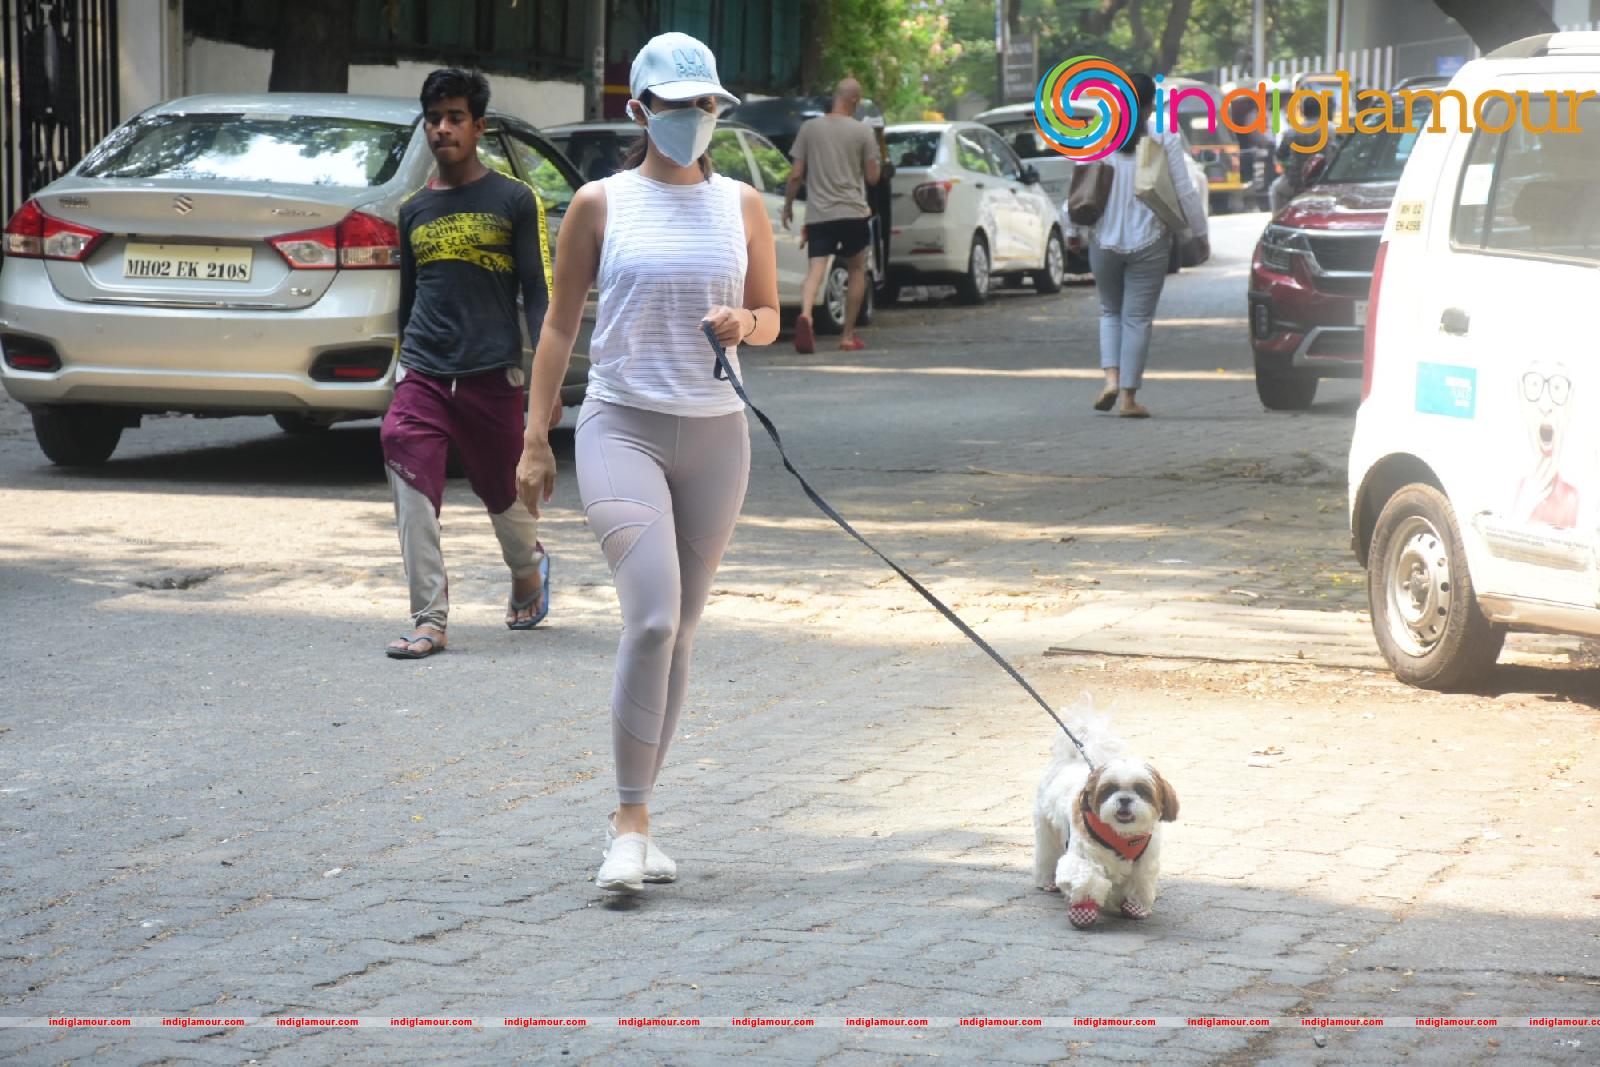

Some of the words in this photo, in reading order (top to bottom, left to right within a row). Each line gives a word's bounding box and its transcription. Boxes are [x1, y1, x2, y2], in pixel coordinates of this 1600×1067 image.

[444, 232, 482, 250] SCENE
[127, 259, 170, 276] MH02
[176, 261, 199, 277] EK
[206, 263, 248, 279] 2108
